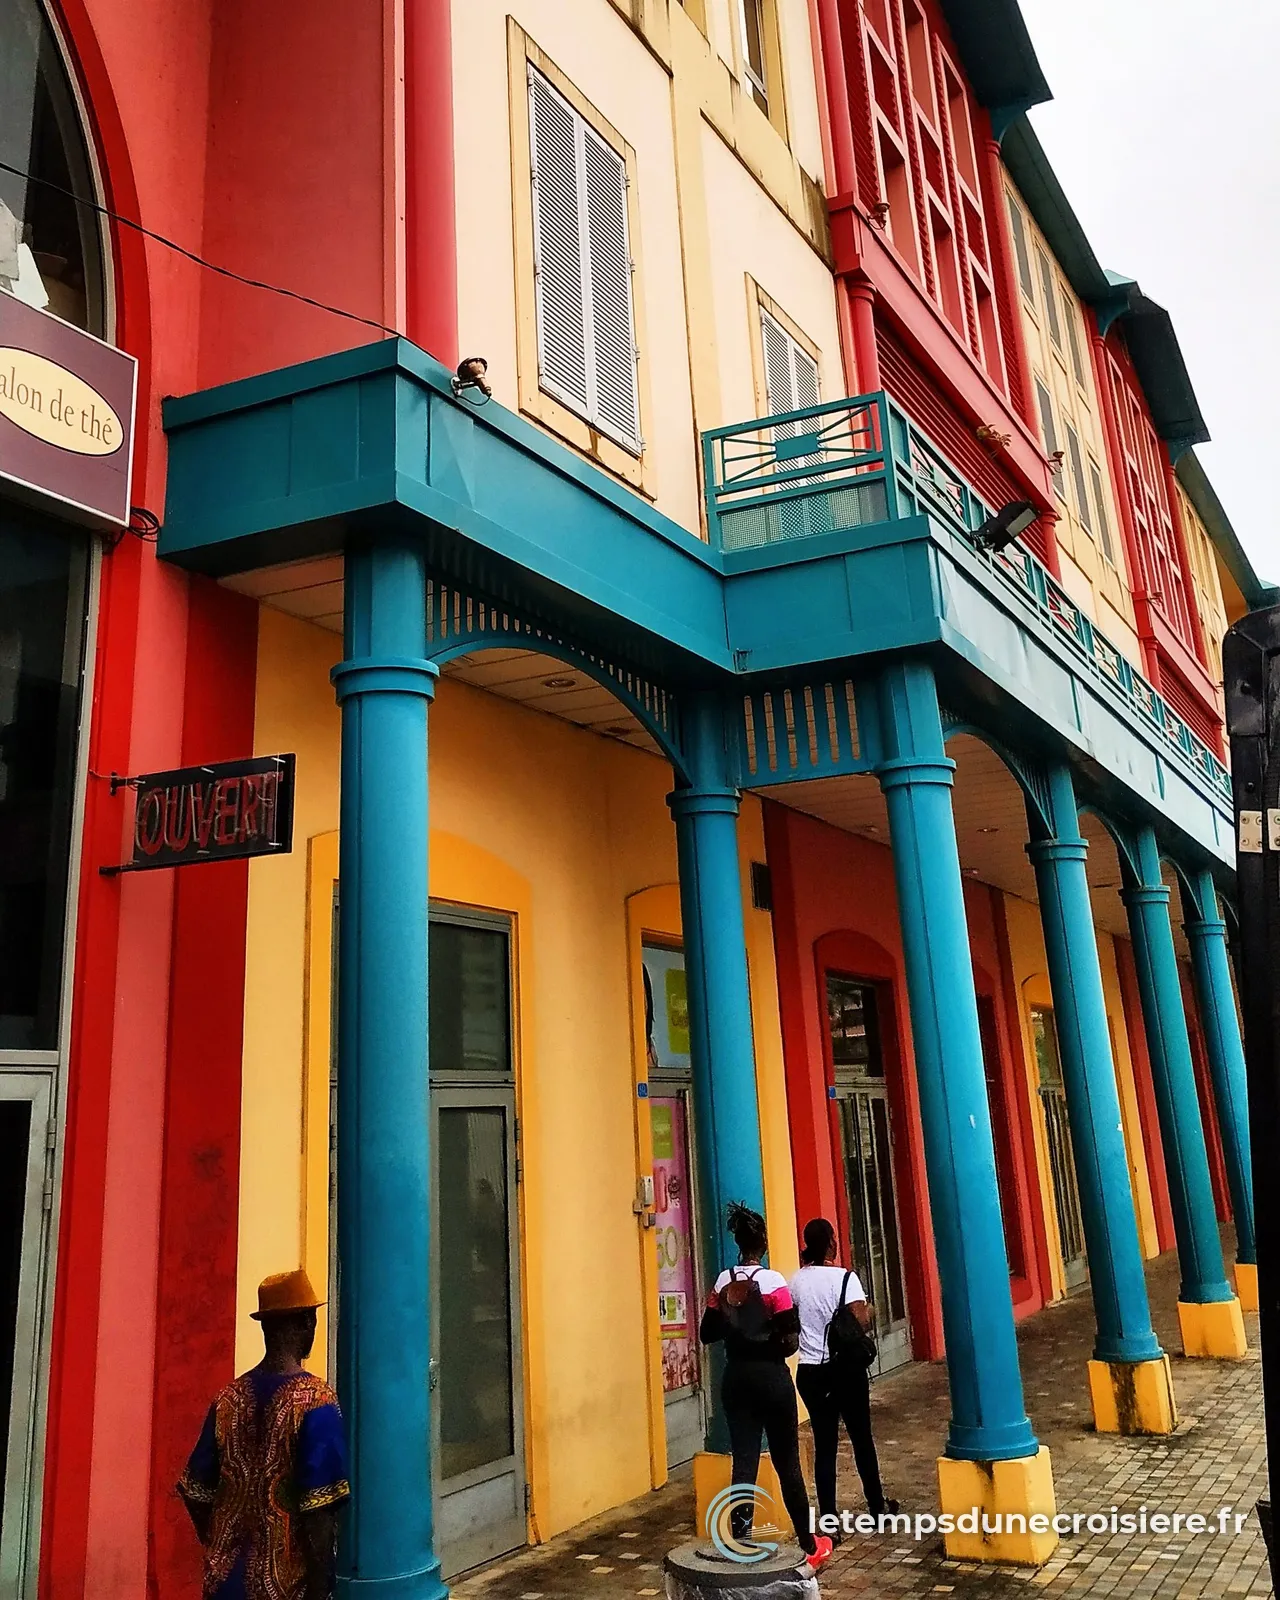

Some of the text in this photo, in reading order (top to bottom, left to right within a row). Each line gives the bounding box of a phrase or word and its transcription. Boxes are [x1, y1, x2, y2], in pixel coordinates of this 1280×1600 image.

[50, 388, 74, 427] de
[81, 404, 112, 445] thé
[136, 770, 284, 855] OUVERT
